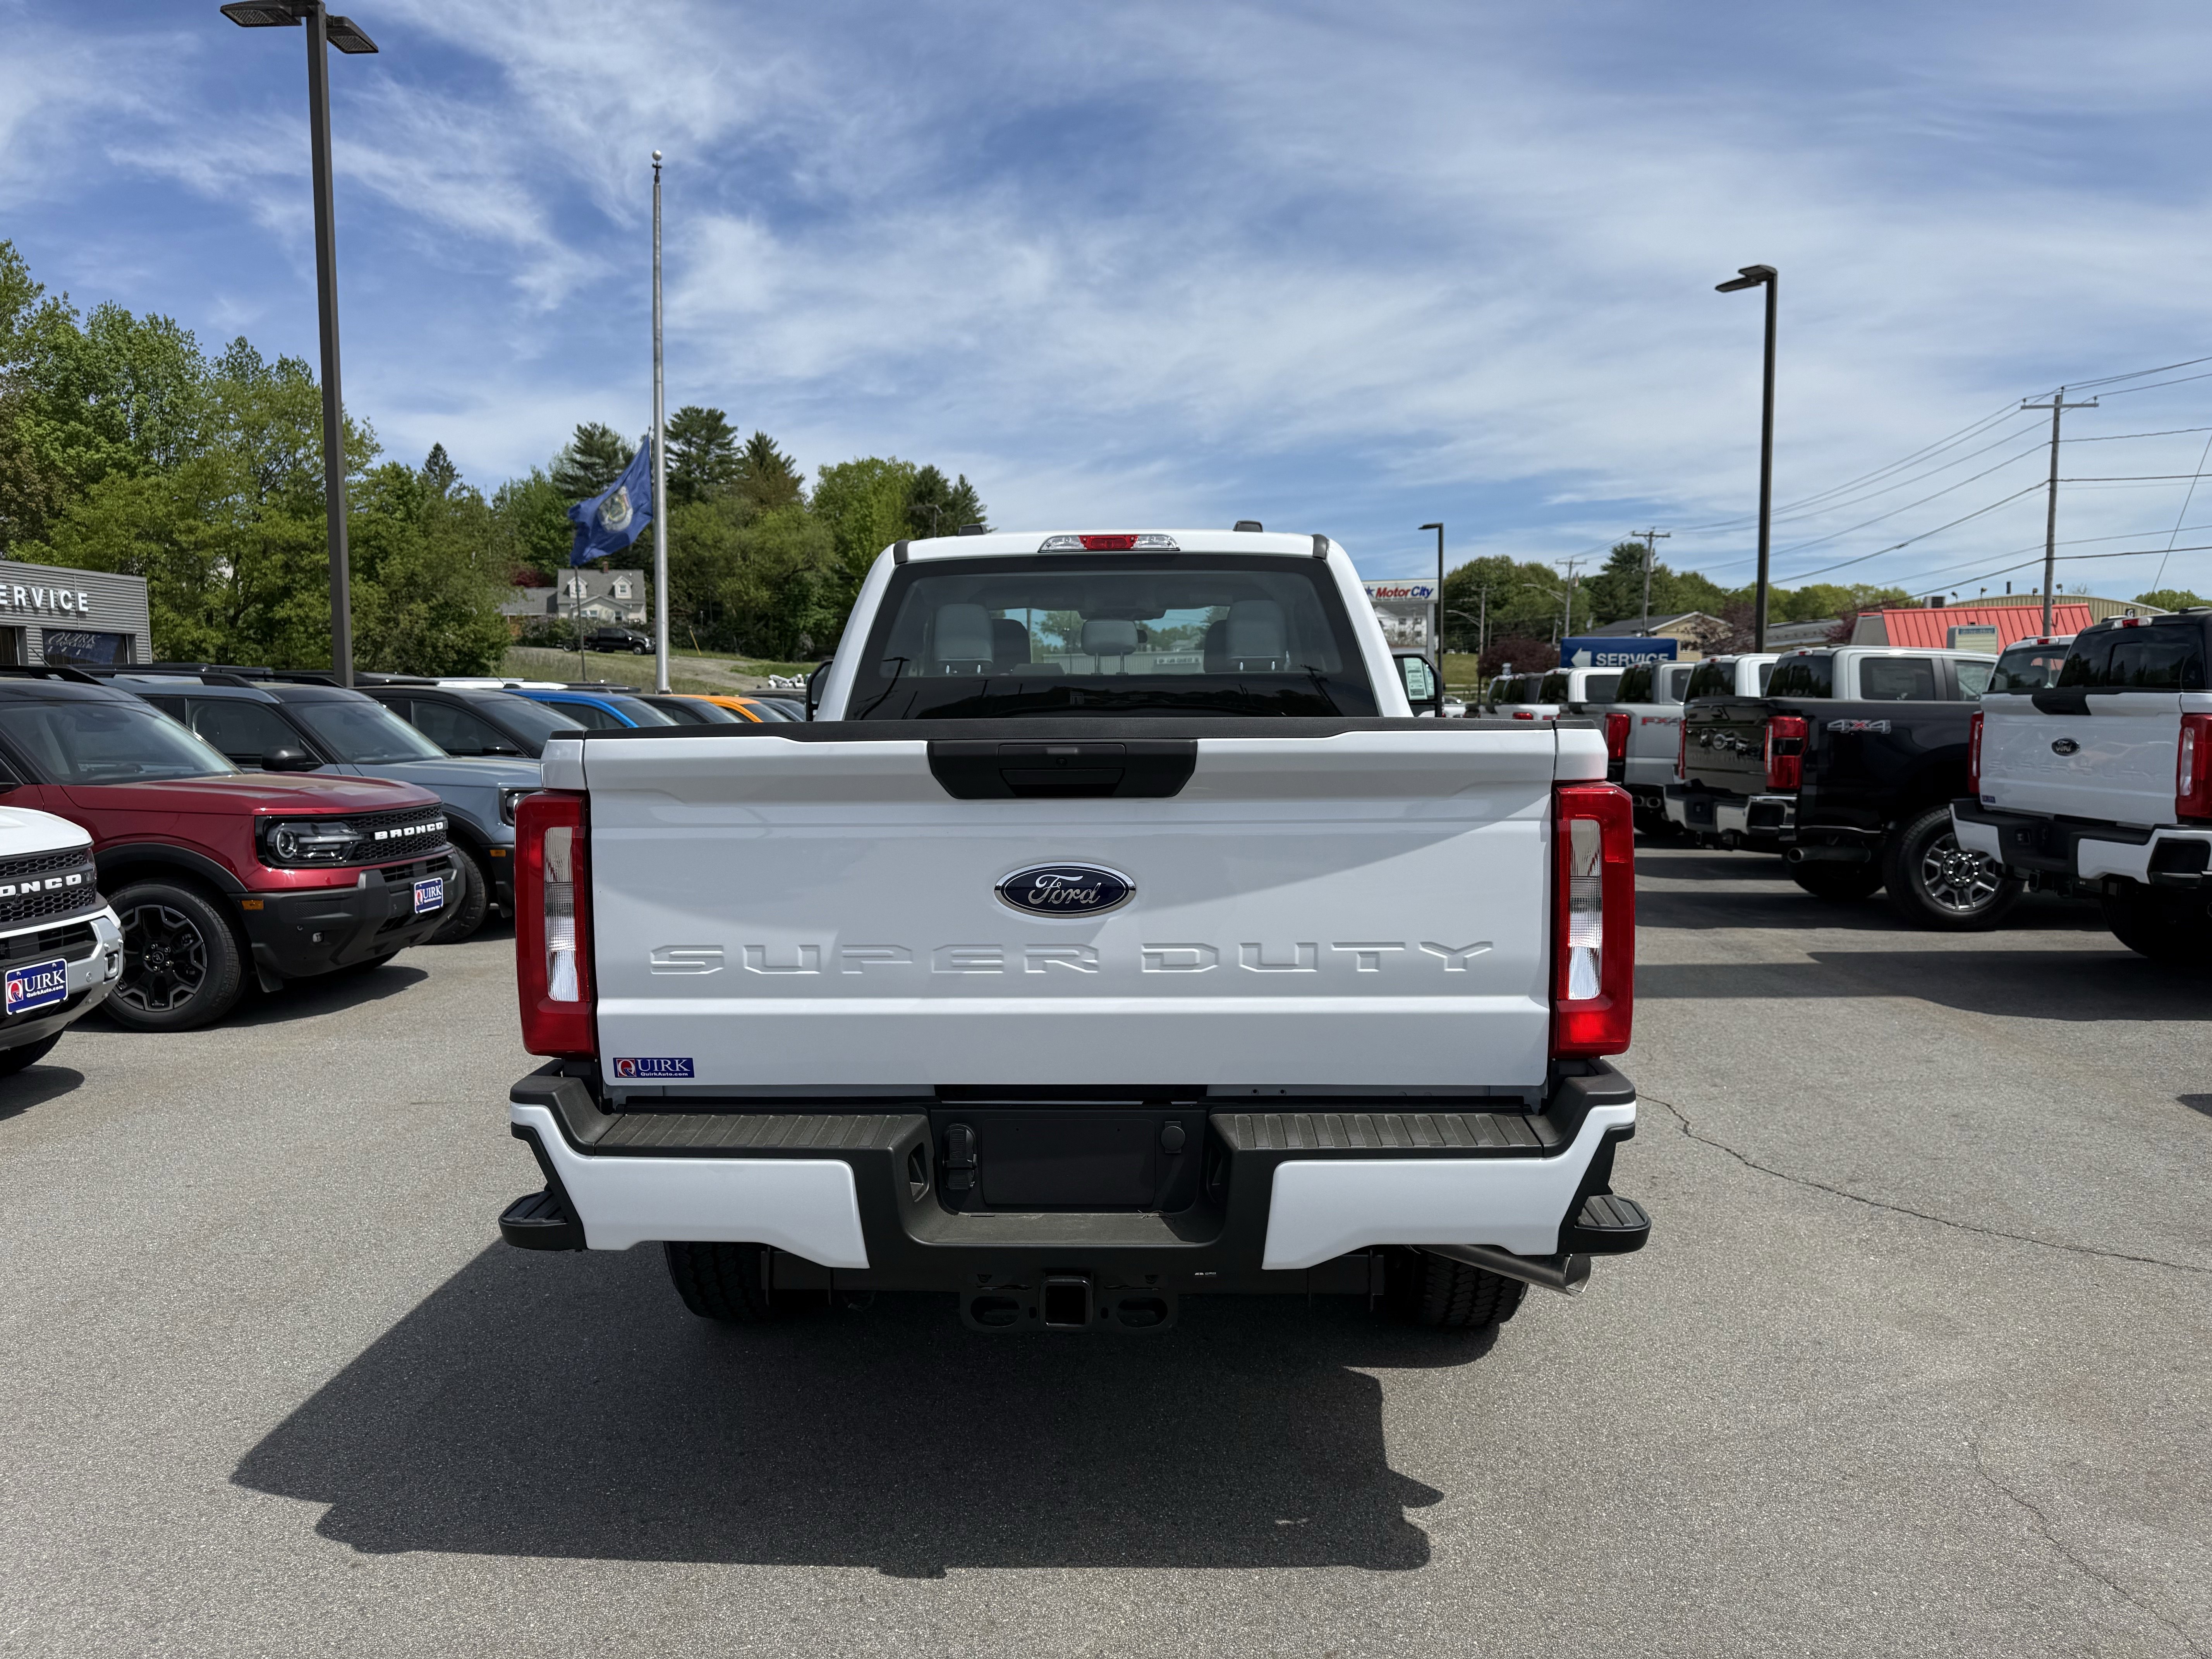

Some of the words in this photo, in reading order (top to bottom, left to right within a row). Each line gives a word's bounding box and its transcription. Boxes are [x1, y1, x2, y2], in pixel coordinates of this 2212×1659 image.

[374, 822, 443, 840] BRONCO
[416, 885, 442, 905] QUIRK
[1028, 874, 1102, 904] Ford
[651, 944, 1099, 974] SUPER
[1141, 941, 1494, 972] DUTY
[8, 969, 65, 1003] QUIRK
[26, 985, 64, 998] QuirkAuto.com
[617, 1059, 690, 1077] QUIRK
